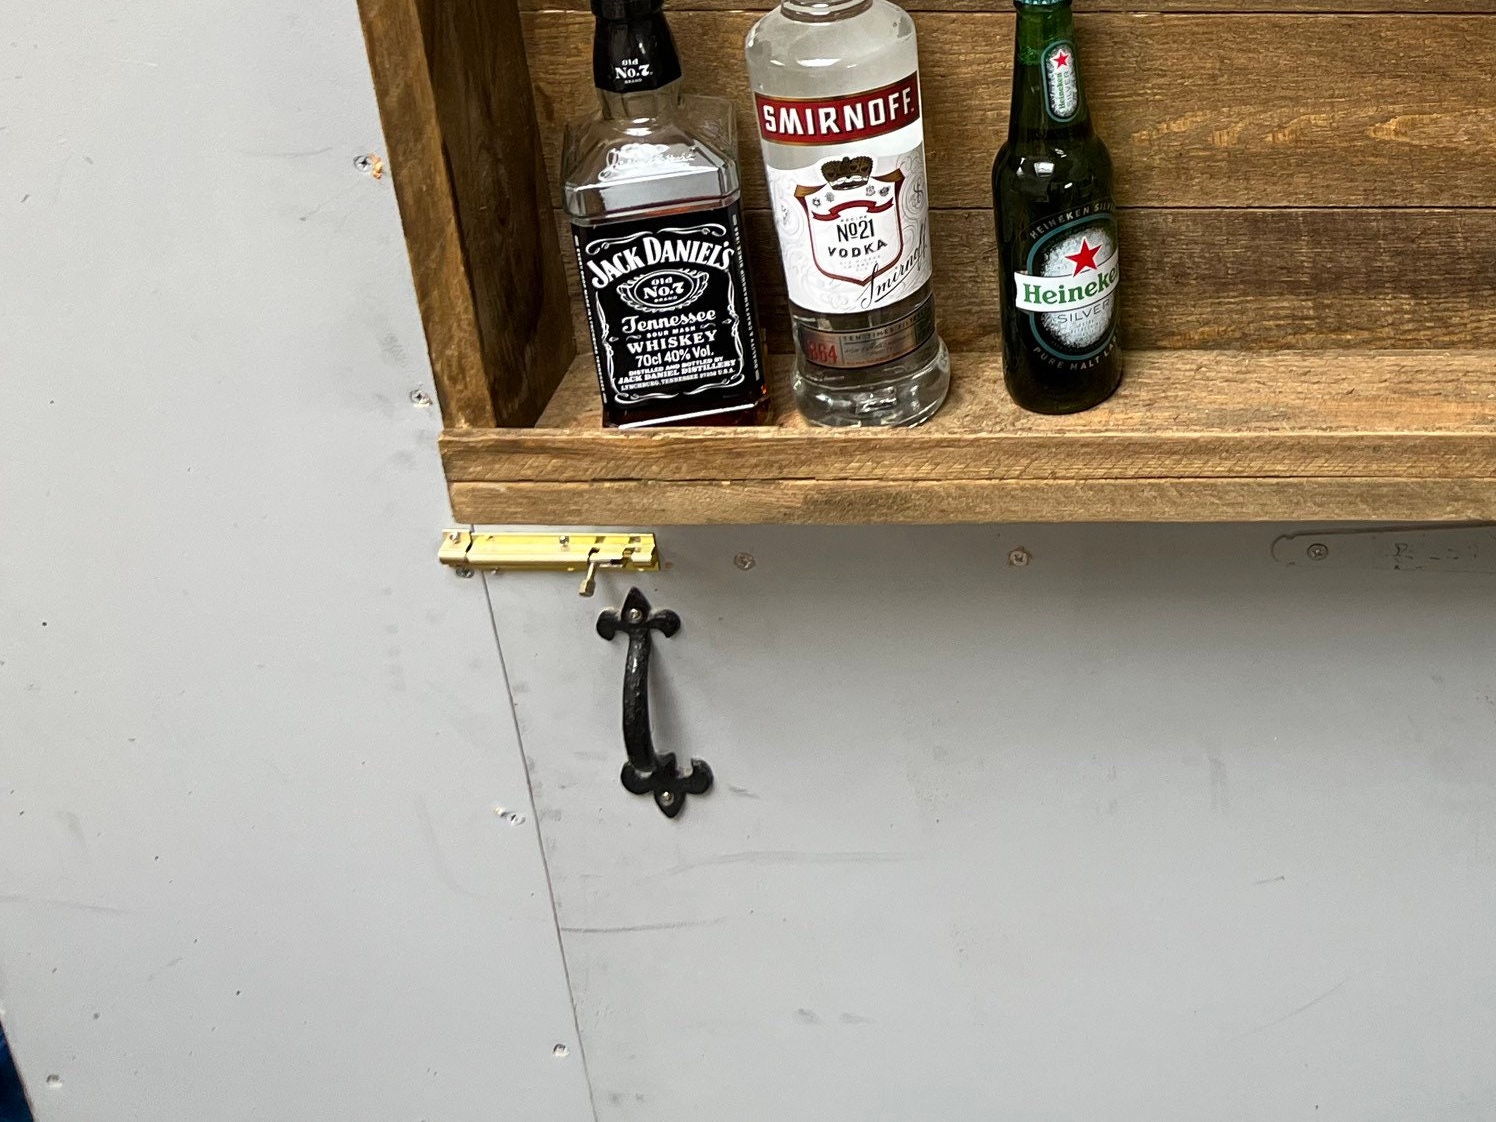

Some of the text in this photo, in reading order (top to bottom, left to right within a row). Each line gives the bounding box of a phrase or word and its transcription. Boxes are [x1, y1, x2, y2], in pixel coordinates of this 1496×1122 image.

[615, 64, 650, 80] No.7
[621, 58, 639, 66] Old
[763, 87, 911, 135] SMIRNOFF
[1029, 206, 1090, 239] HEINEKEN
[827, 239, 888, 258] VODKA
[586, 236, 735, 289] JACK DANIEL'S
[643, 281, 685, 300] No.7
[651, 277, 673, 286] Old
[1057, 298, 1111, 324] SILVER
[621, 310, 717, 334] Tennessee
[646, 325, 696, 338] SOUR MASH
[626, 330, 717, 354] WHISKEY
[635, 344, 714, 367] 70cl 40% Vol.
[681, 358, 713, 368] BOTTLED
[1033, 346, 1064, 369] PURE
[1069, 355, 1100, 370] MALT
[618, 375, 642, 384] JACK
[644, 369, 680, 380] DANIEL
